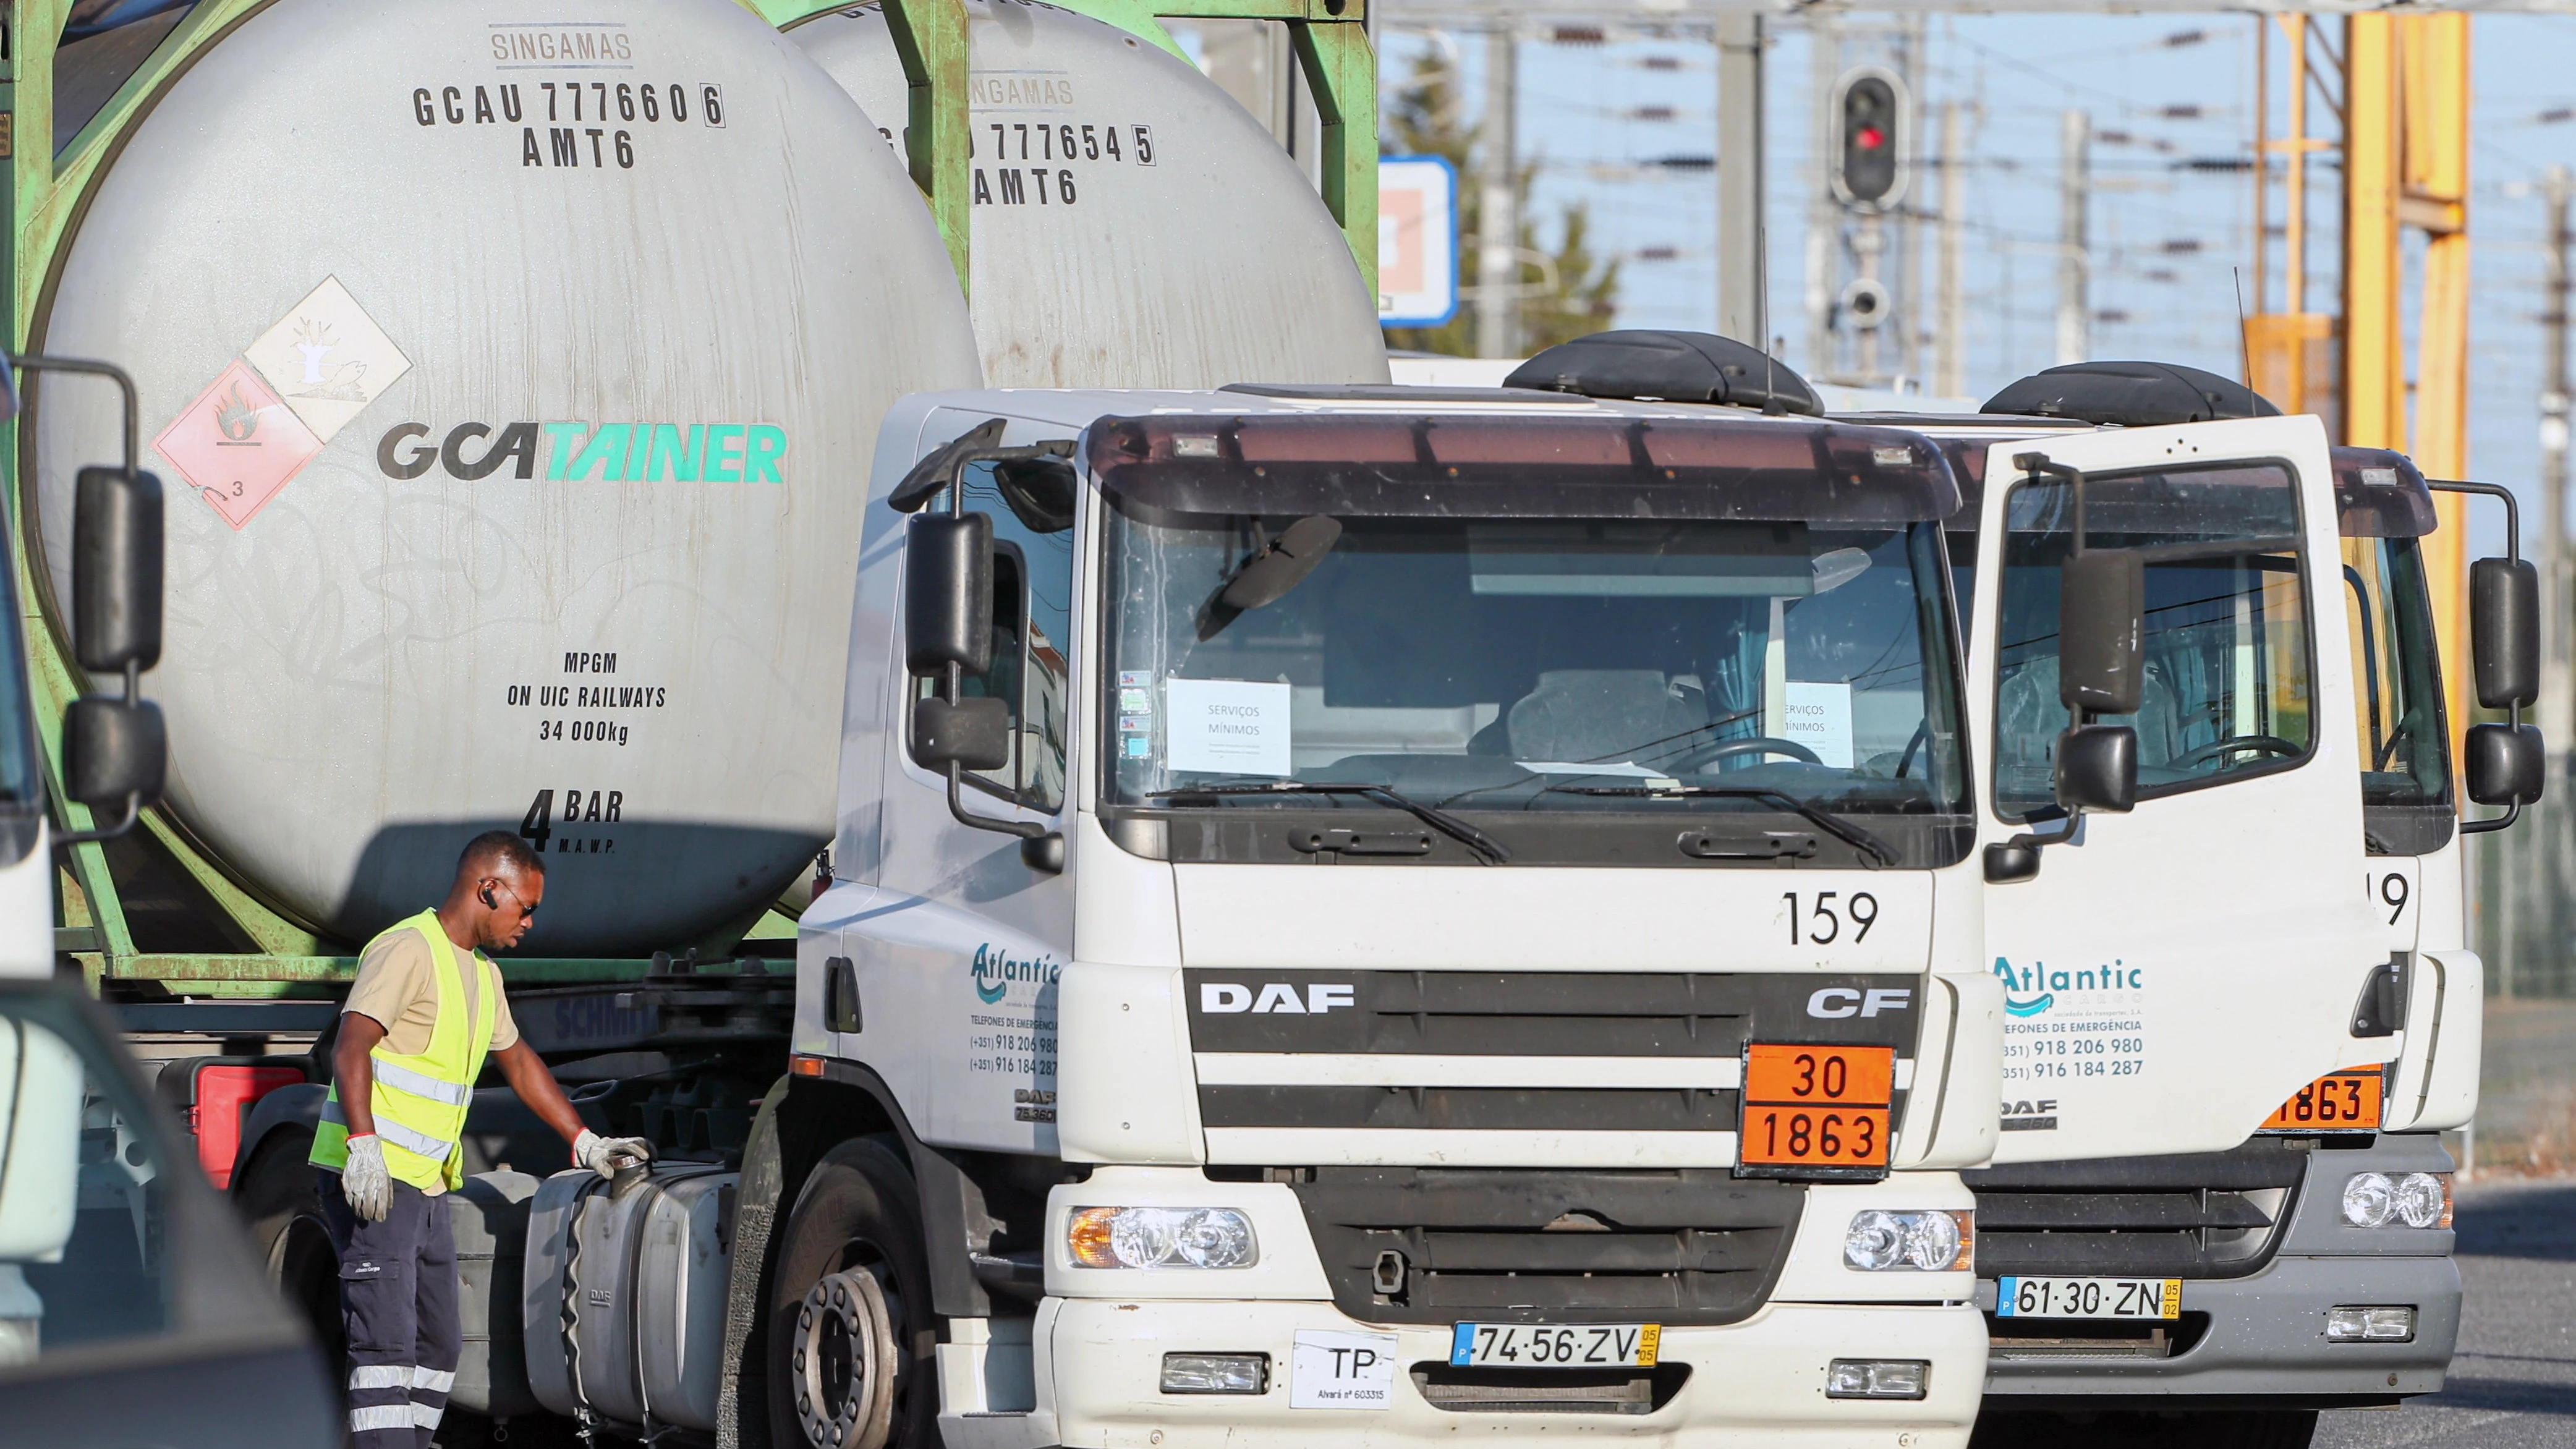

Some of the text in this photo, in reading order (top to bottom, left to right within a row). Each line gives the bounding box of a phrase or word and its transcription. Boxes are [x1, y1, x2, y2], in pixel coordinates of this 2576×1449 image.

[491, 33, 632, 61] SINGAMAS
[971, 79, 1073, 104] NGAMAS
[413, 82, 721, 125] GCAU 777660 6
[522, 128, 634, 168] AMT6
[991, 124, 1121, 161] 777654
[1136, 128, 1152, 163] 5
[975, 168, 1076, 205] AMT6
[376, 422, 787, 483] GCATAINER
[232, 480, 244, 496] 3
[564, 652, 616, 673] MPGM
[508, 686, 666, 707] ON UIC RAILWAYS
[1208, 705, 1260, 718] SERVIÇOS
[1785, 705, 1824, 716] ERVIÇOS
[540, 720, 628, 746] 34 000kg
[1209, 721, 1260, 736] MÍNIMOS
[519, 789, 623, 852] 4 BAR
[2366, 873, 2408, 926] 9
[1783, 891, 1878, 945] 159
[971, 943, 1058, 985] Atlantic
[1992, 957, 2141, 992] Atlantic
[1200, 983, 1354, 1013] DAF
[1806, 987, 1911, 1019] CF
[971, 1015, 1058, 1030] TELEFONES DE EMERGÊNCIA
[2005, 1019, 2142, 1034] EFONES DE EMERGÊNCIA
[971, 1034, 1058, 1053] (+351) 918 206 980
[2004, 1038, 2143, 1058] 351) 918 206 980
[970, 1056, 1057, 1076] (+351) 916 184 287
[1792, 1054, 1846, 1098] 30
[2003, 1060, 2143, 1081] 351) 916 184 287
[1014, 1089, 1056, 1105] DAF
[1764, 1113, 1874, 1158] 1863
[2166, 1284, 2178, 1296] 05
[2002, 1301, 2010, 1311] P
[2164, 1304, 2177, 1315] 02
[1642, 1330, 1656, 1341] 05
[1328, 1348, 1375, 1379] TP
[1459, 1348, 1467, 1358] P
[1639, 1349, 1654, 1361] 05
[1317, 1388, 1341, 1398] Alvará
[1354, 1390, 1384, 1400] 603315
